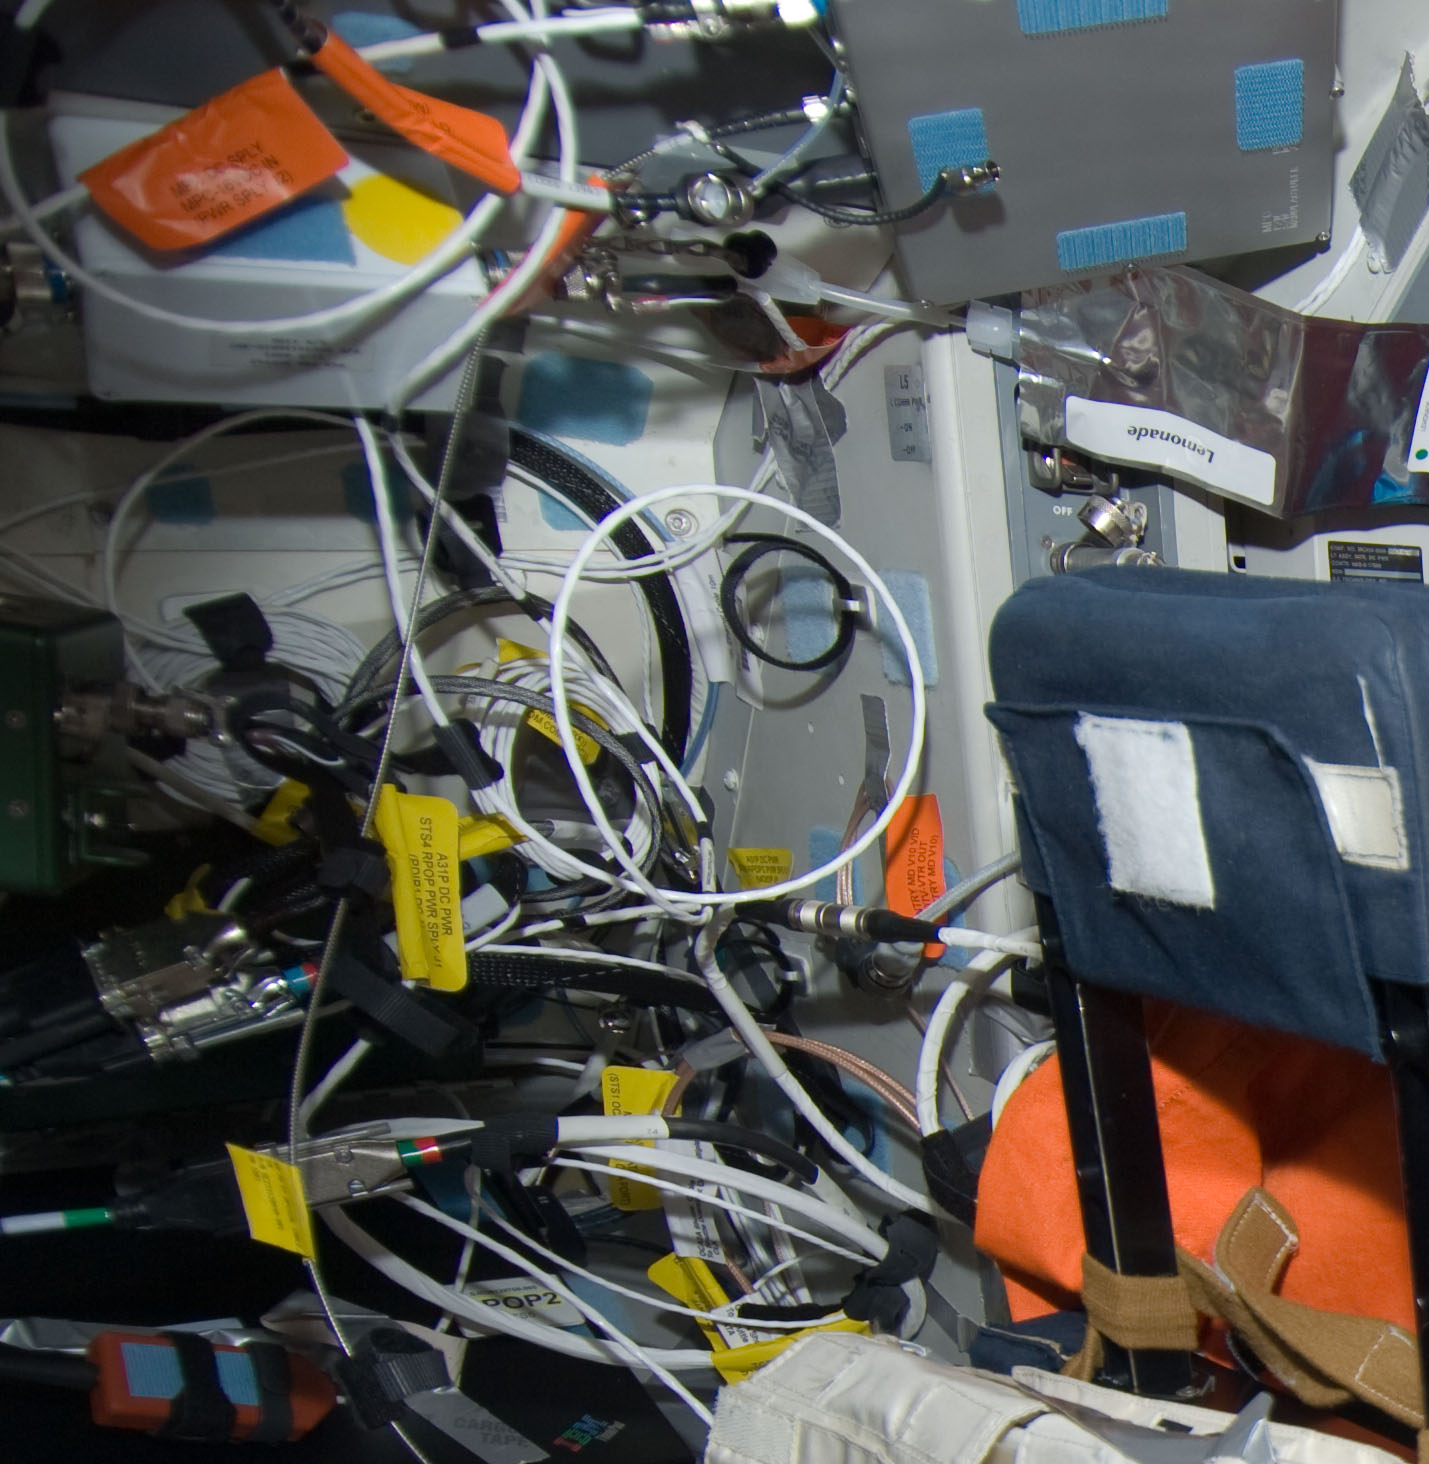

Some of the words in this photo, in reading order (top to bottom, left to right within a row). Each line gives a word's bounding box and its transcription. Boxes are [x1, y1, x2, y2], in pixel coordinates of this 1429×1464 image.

[1127, 425, 1215, 464] Lemonade
[1052, 505, 1073, 516] OFF
[419, 816, 432, 851] STS4
[422, 852, 434, 885] RPOP
[436, 851, 449, 883] A31P
[439, 886, 450, 904] DC
[442, 906, 453, 936] PWR
